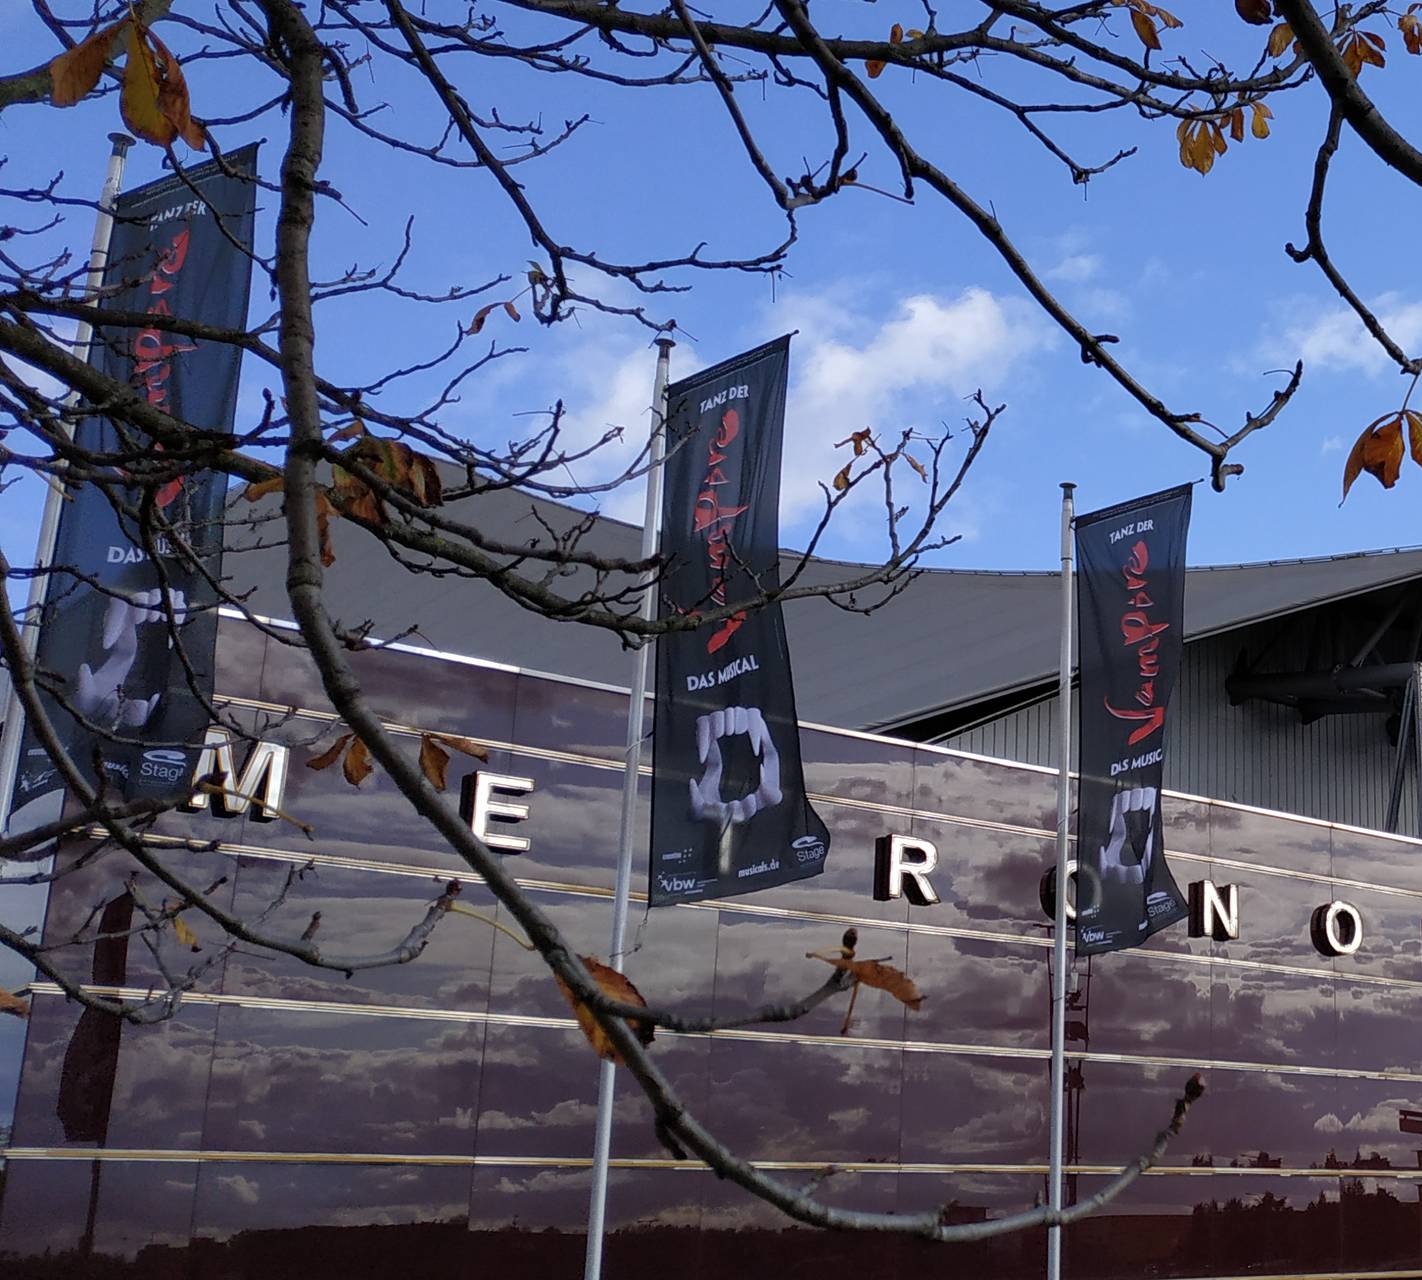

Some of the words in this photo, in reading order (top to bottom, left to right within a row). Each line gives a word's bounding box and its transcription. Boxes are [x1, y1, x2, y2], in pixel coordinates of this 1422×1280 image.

[700, 389, 728, 414] TANZ
[728, 384, 749, 400] DER
[1109, 523, 1135, 544] TANZ
[1137, 519, 1154, 533] DER
[1104, 540, 1170, 746] Vampire
[686, 671, 715, 692] DAS
[718, 654, 759, 685] MUSICAL
[796, 845, 825, 862] Stage
[664, 877, 696, 892] vbw
[1147, 899, 1176, 917] Stage
